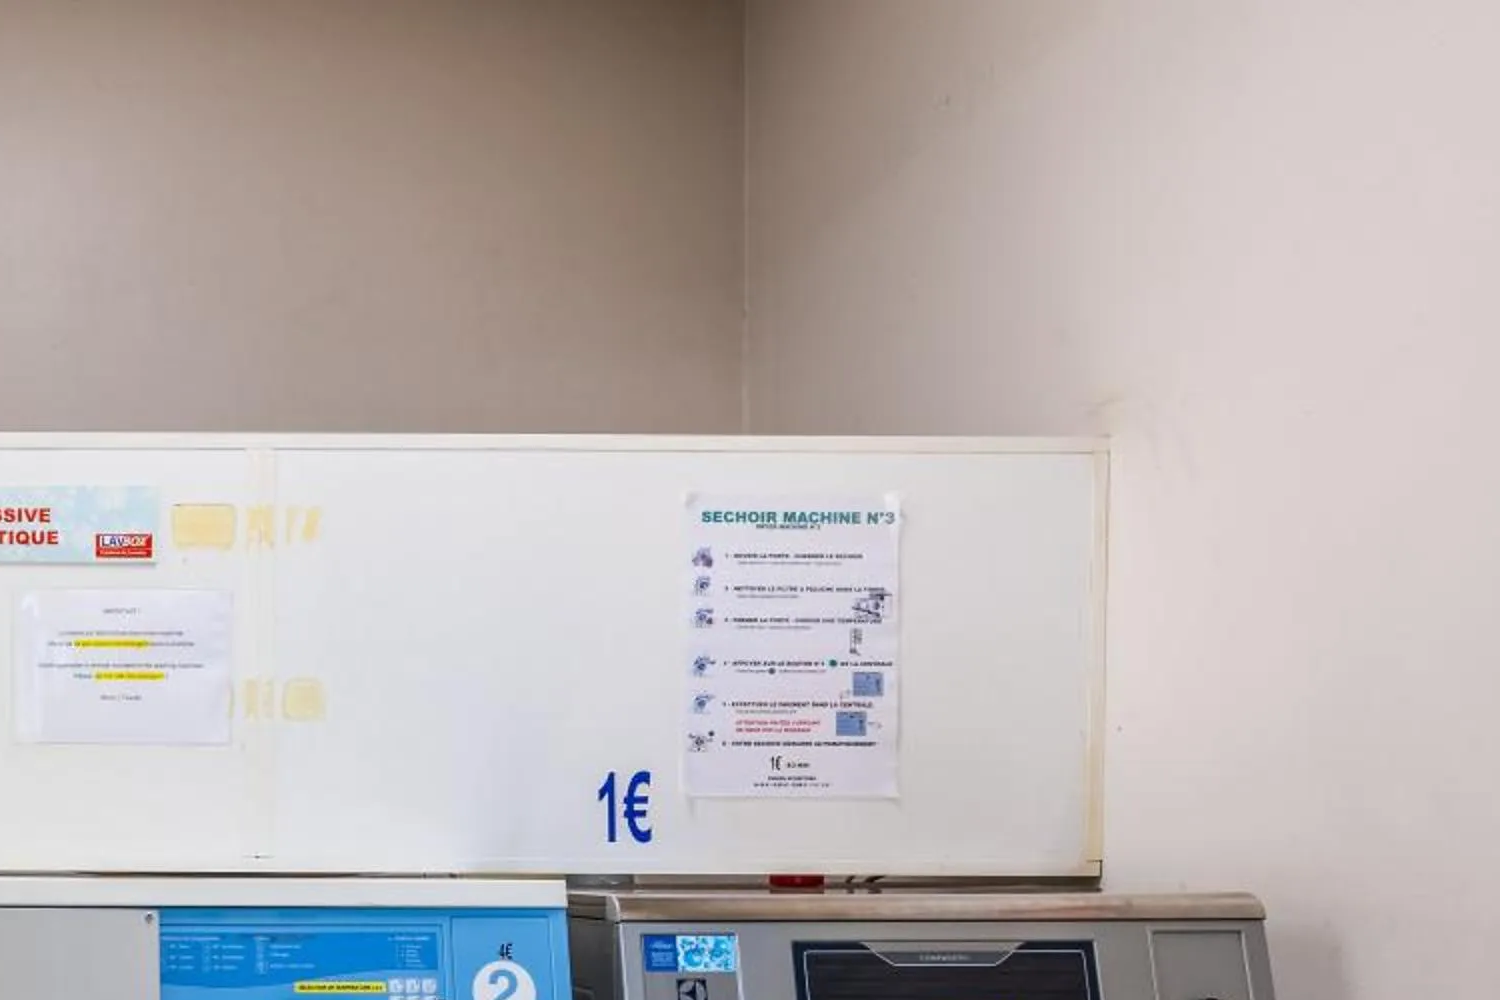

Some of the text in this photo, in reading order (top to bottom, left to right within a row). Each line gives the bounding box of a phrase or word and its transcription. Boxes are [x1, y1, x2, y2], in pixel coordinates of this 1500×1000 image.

[701, 510, 778, 524] SECHOIR
[782, 510, 862, 524] MACHINE
[598, 771, 652, 843] 1€
